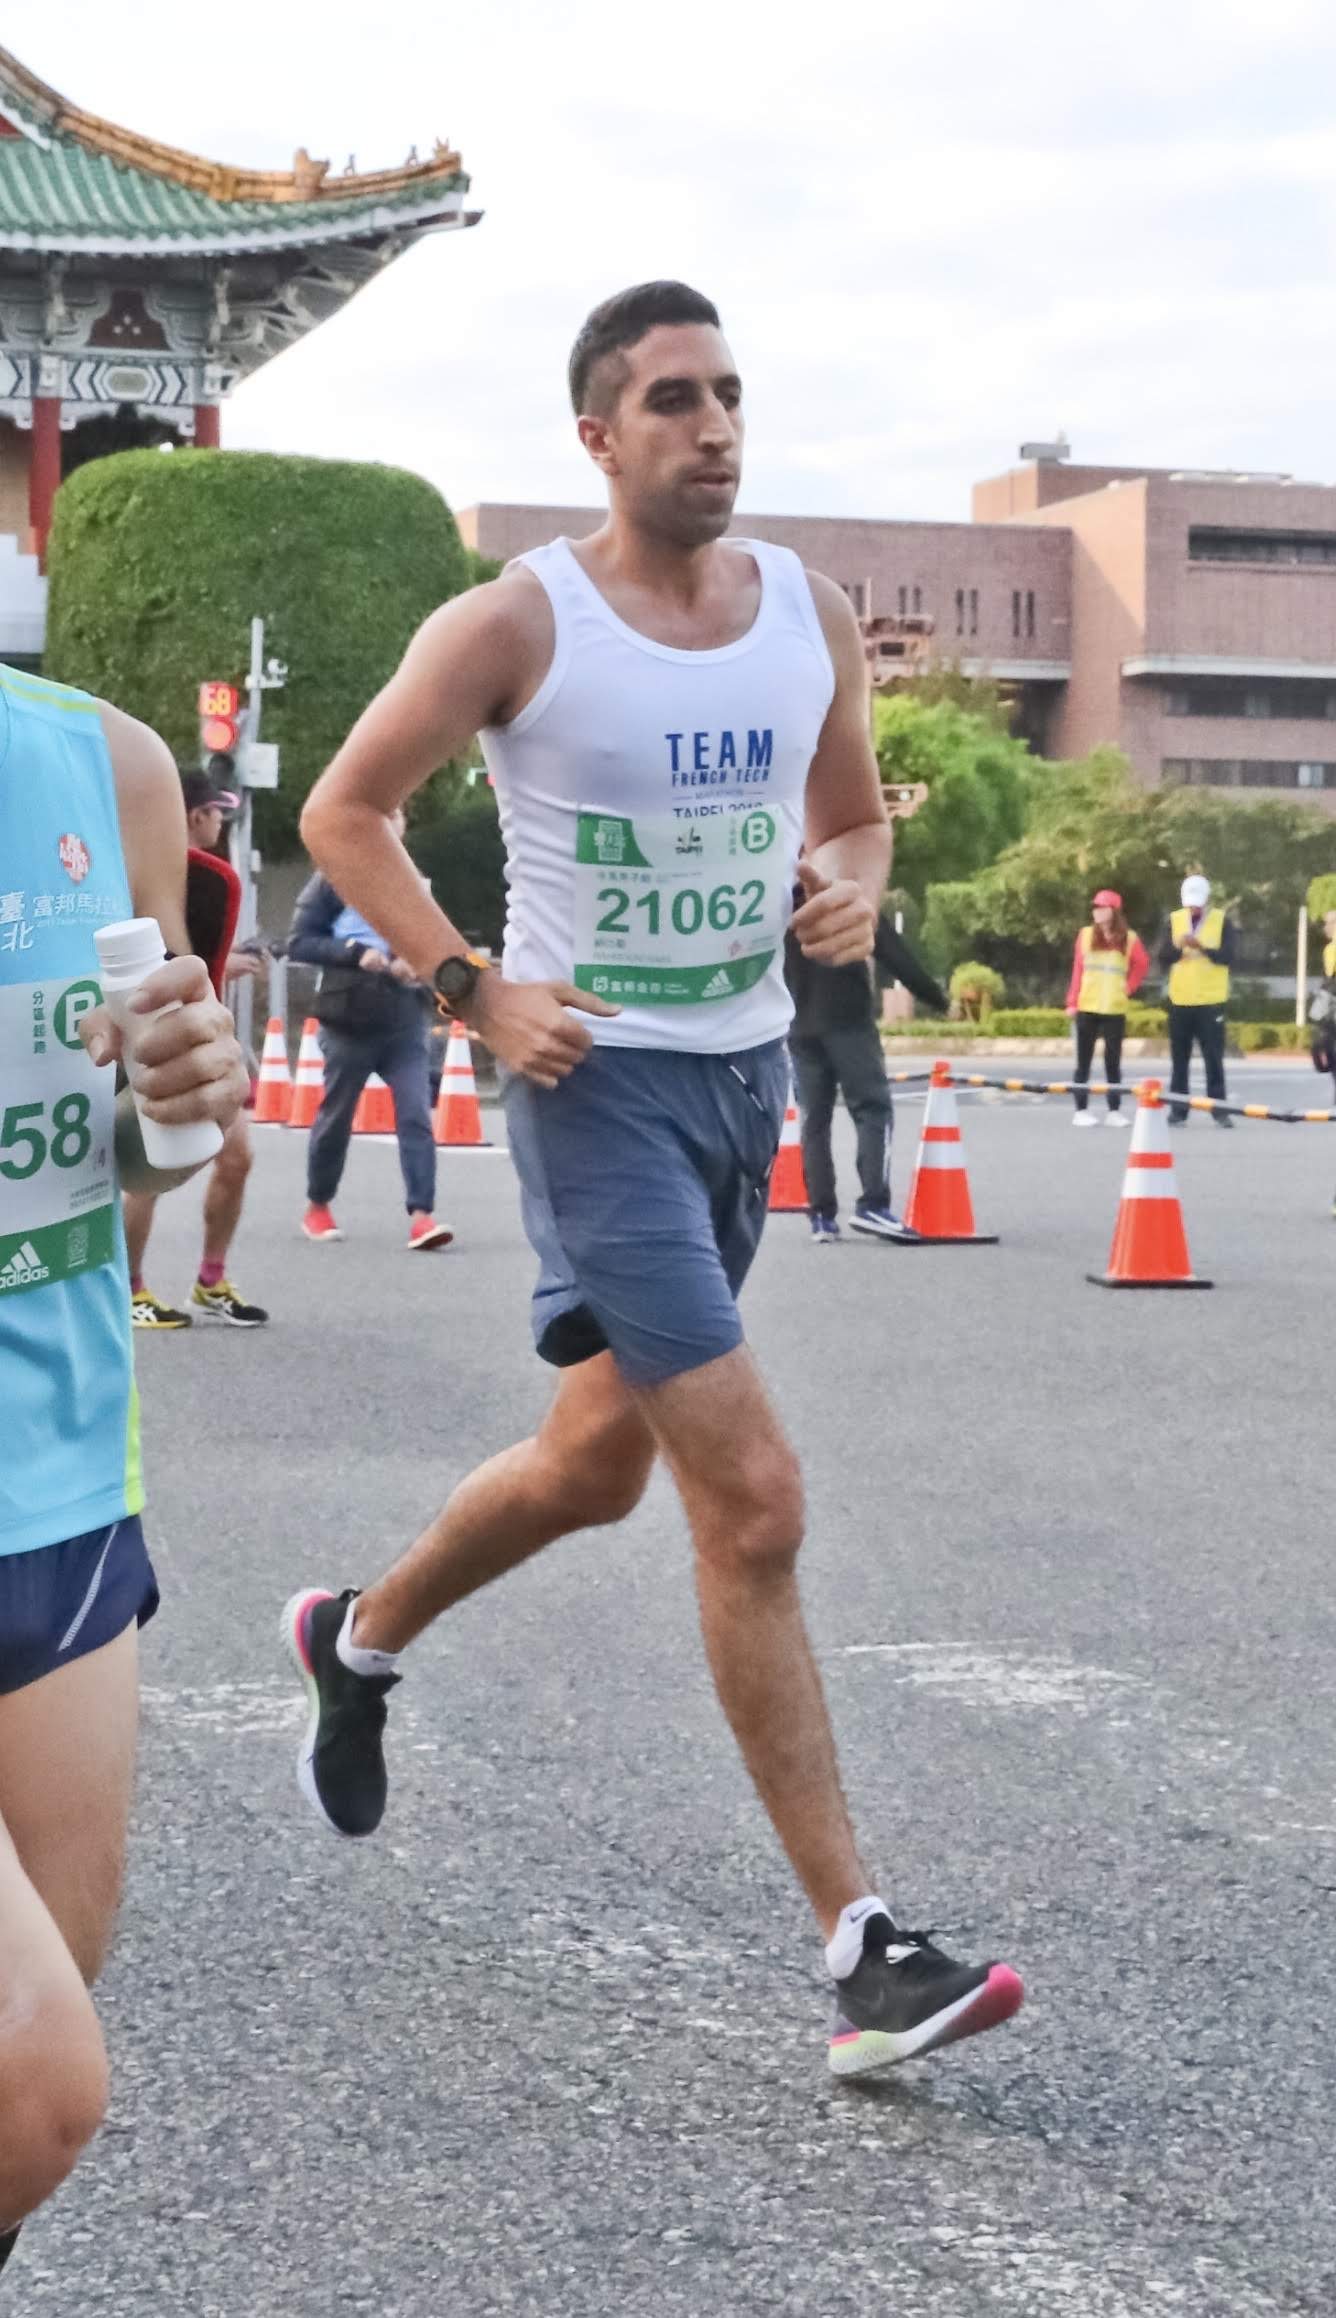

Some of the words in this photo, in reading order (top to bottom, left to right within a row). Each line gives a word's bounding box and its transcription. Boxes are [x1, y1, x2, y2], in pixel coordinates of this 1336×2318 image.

[665, 729, 773, 772] TEAM
[672, 770, 727, 788] FRENCH
[737, 769, 769, 783] TECH
[596, 879, 766, 935] 21062
[0, 1092, 91, 1180] 58
